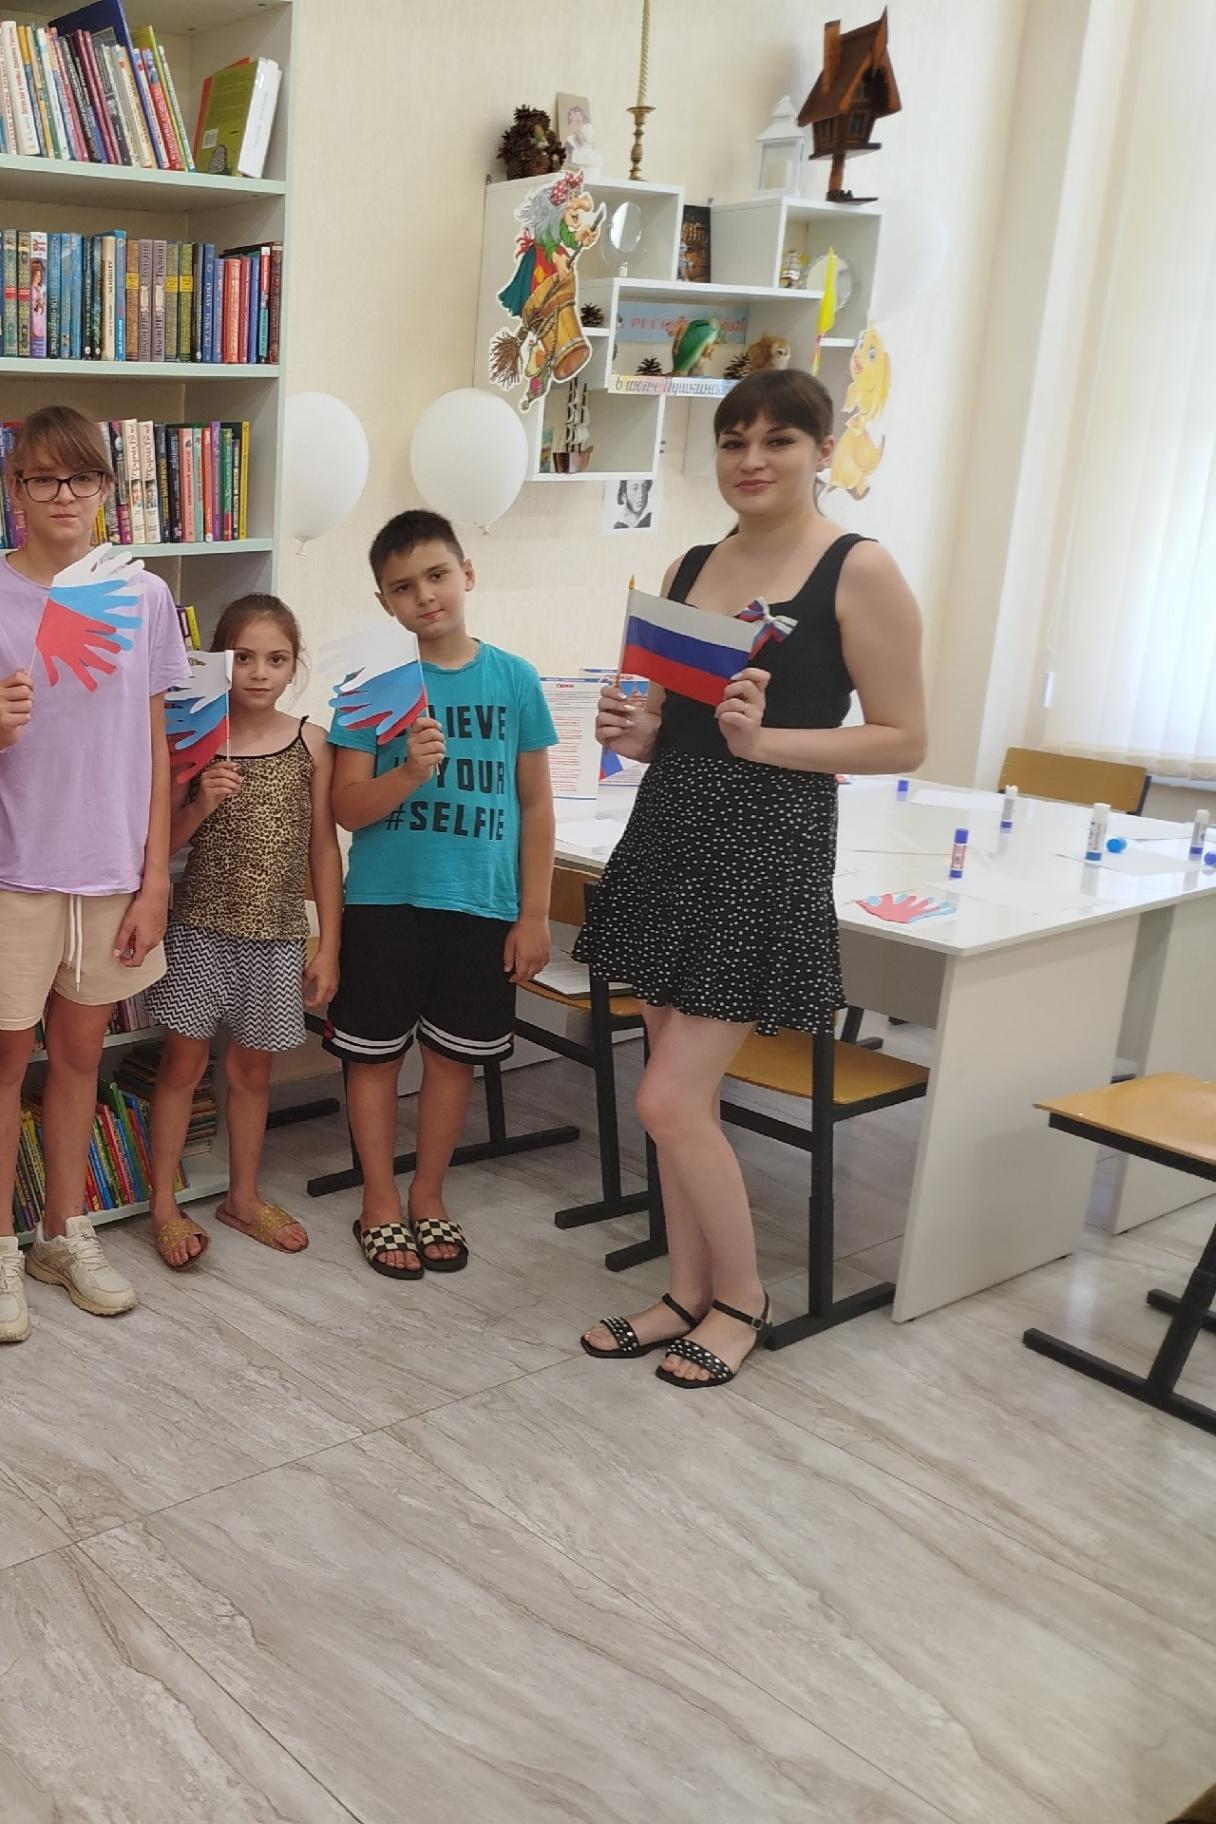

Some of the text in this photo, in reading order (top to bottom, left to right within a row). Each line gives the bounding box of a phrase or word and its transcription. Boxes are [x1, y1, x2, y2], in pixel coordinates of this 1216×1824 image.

[664, 378, 733, 396] Пушкинск
[429, 704, 508, 742] IEVE
[437, 756, 505, 795] YOUR
[385, 800, 505, 841] #SELFIE
